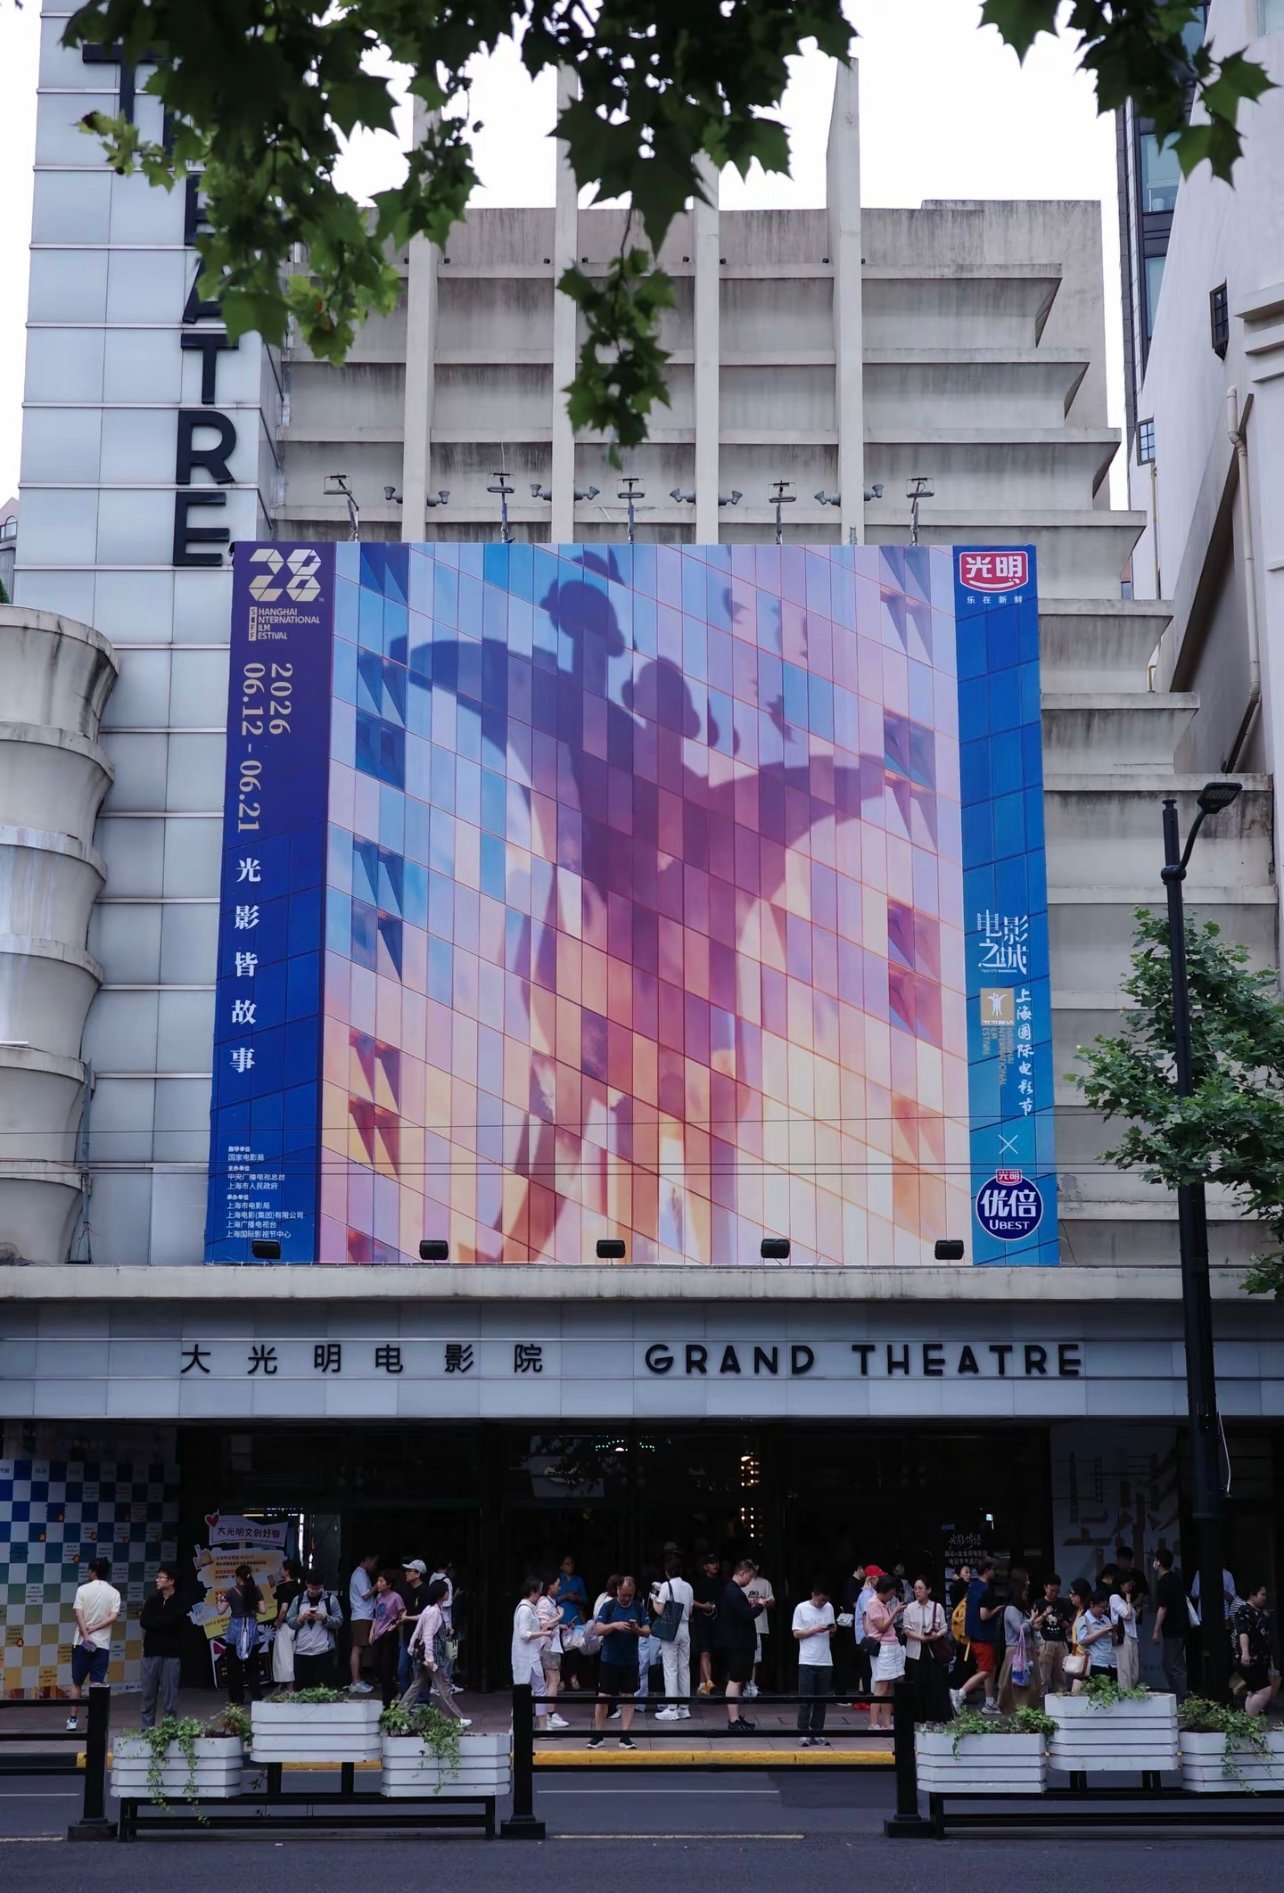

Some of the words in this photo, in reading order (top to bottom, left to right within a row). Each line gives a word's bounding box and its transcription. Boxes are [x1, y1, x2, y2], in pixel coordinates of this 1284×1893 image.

[248, 549, 321, 601] 28
[966, 556, 1022, 578] 光明
[241, 663, 265, 736] 06.12
[269, 663, 293, 735] 2026
[238, 760, 262, 832] 06.21
[230, 858, 262, 1073] 光影皆故事
[1016, 988, 1034, 1116] 上海国际电影节
[227, 1182, 278, 1190] 上海市人民政府
[981, 1189, 1037, 1217] 优倍
[989, 1219, 1030, 1230] UBEST
[180, 1343, 544, 1374] 大光明电影院
[645, 1344, 815, 1374] GRAND
[851, 1343, 1082, 1376] THEATRE
